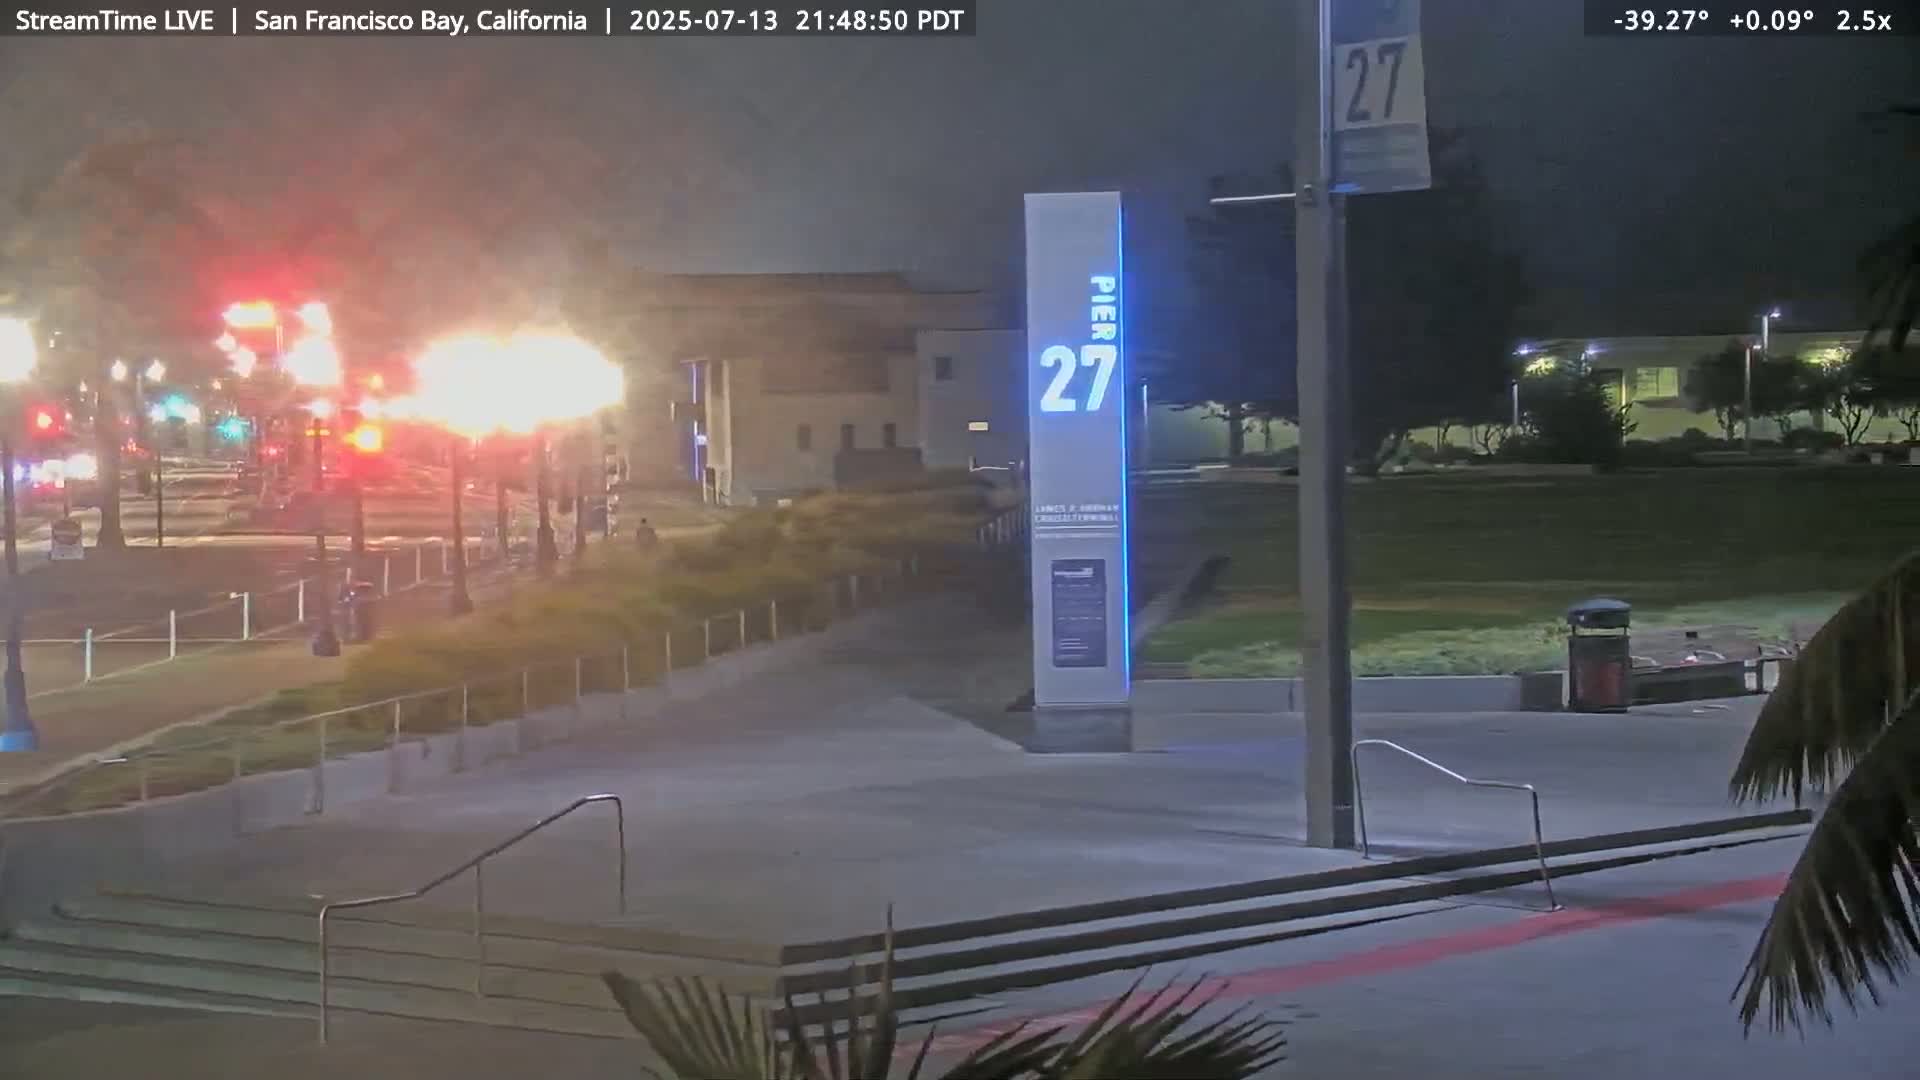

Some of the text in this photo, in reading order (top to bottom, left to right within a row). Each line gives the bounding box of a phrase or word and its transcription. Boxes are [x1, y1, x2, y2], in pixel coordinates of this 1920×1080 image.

[1346, 43, 1406, 122] 27
[1091, 275, 1117, 341] PIER
[1040, 344, 1117, 411] 27
